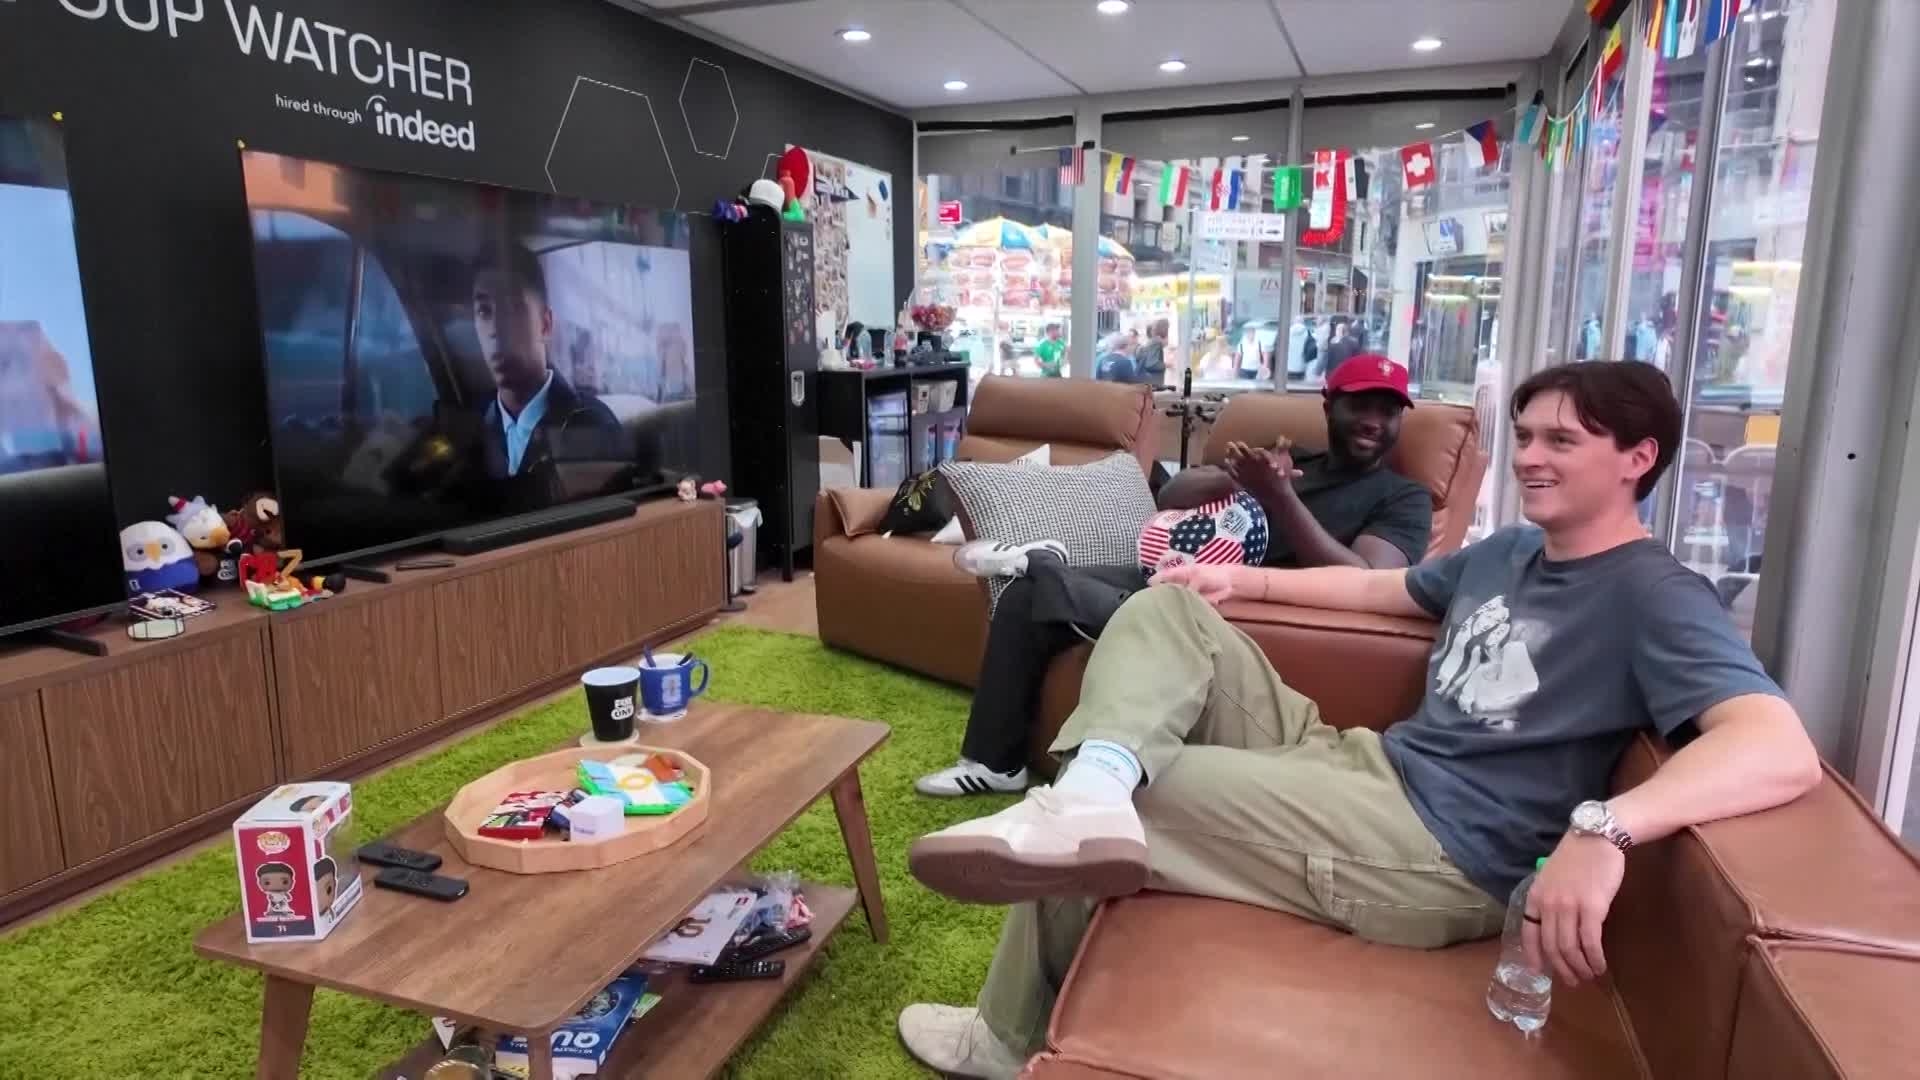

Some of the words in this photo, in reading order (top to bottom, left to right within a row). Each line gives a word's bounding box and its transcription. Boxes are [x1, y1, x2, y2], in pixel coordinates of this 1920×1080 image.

[223, 0, 473, 106] WATCHER
[275, 93, 310, 112] hired
[313, 101, 362, 124] through
[372, 100, 476, 151] indeed
